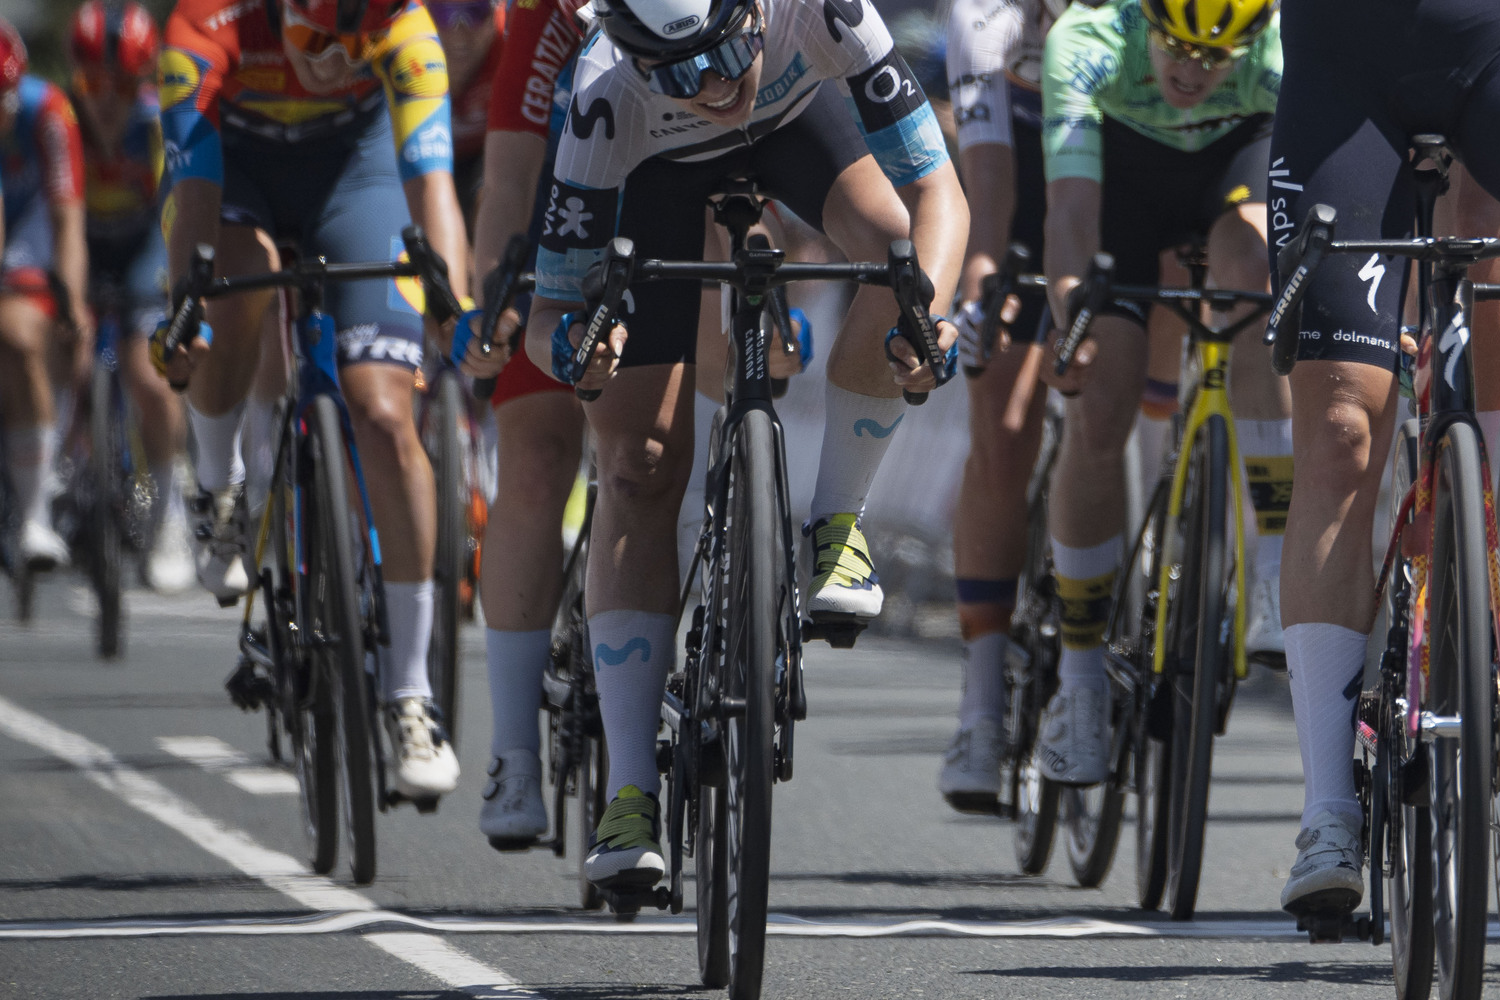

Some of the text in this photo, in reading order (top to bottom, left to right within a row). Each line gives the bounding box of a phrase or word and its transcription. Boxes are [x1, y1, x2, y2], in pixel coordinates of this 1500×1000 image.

[668, 17, 696, 32] ABUS
[520, 8, 575, 125] CERATIZI
[650, 120, 712, 138] CANYO
[543, 184, 559, 236] vivo
[1269, 265, 1309, 328] SRAM
[576, 303, 609, 365] SRAM
[745, 328, 754, 381] CANYON
[1333, 329, 1390, 350] dolmans
